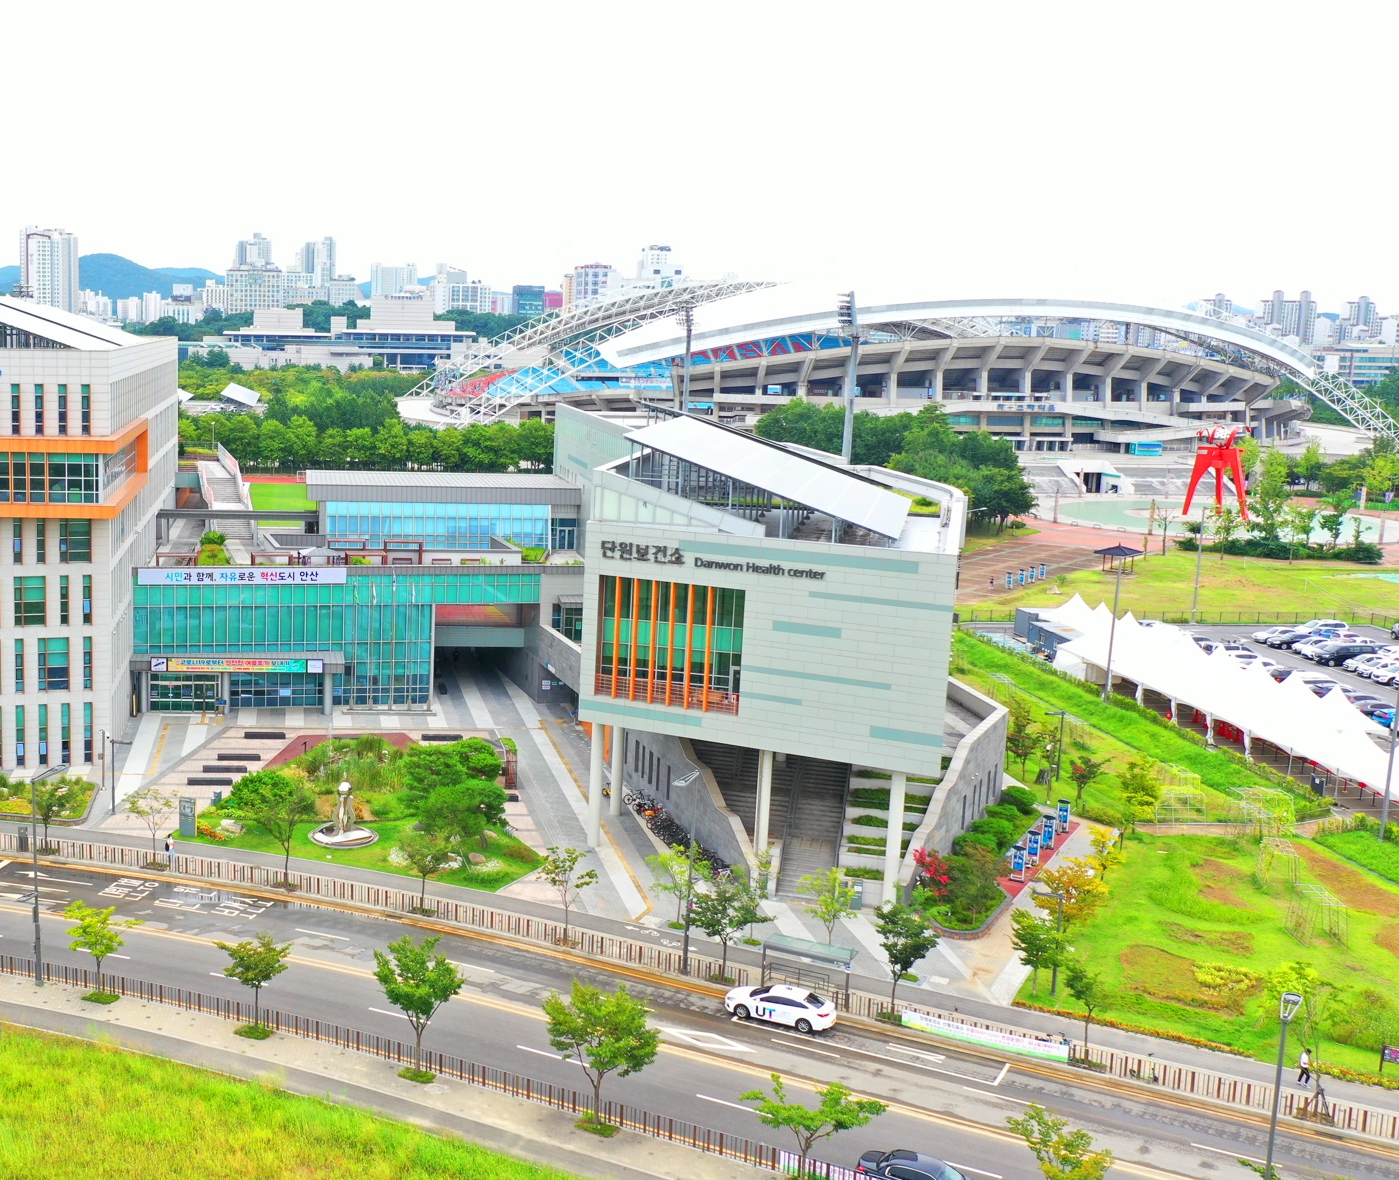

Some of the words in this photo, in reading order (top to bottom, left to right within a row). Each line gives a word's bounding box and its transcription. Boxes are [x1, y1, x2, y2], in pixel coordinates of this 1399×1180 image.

[601, 540, 685, 565] 단원보건소
[165, 572, 192, 582] 시민과
[219, 571, 255, 582] 자유로운
[260, 571, 295, 582] 혁신도시
[299, 571, 319, 582] 안산
[694, 557, 744, 572] Danwon
[746, 562, 785, 576] Health
[787, 567, 826, 580] center
[755, 1005, 776, 1019] UT
